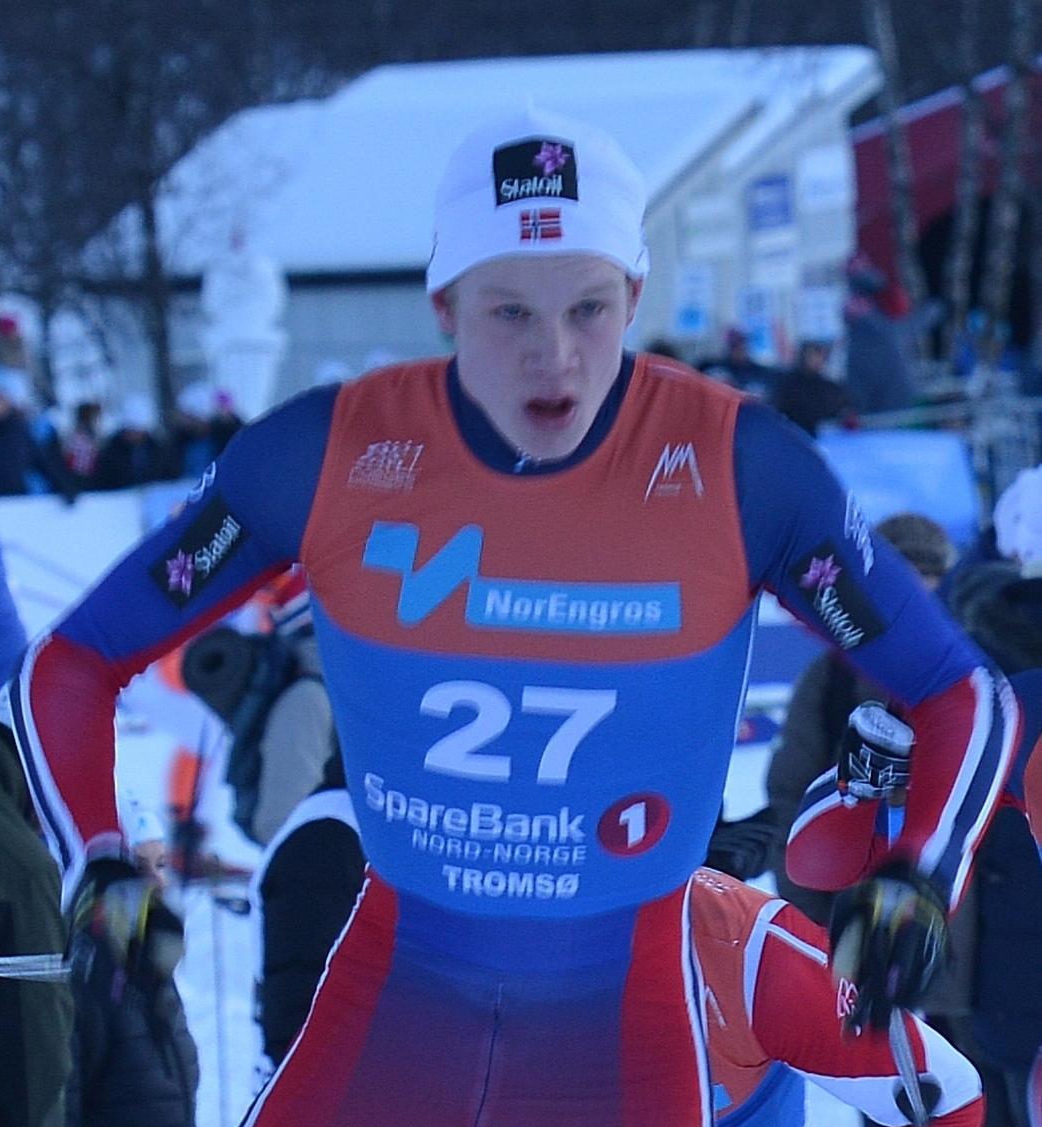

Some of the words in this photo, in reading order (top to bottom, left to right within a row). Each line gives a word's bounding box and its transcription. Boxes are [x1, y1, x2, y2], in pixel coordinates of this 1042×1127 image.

[500, 174, 563, 199] Statoil
[194, 515, 241, 579] Statoil
[484, 588, 663, 630] NorEngros
[814, 586, 865, 650] Statoil
[419, 679, 618, 786] 27
[364, 772, 586, 845] SpareBank
[619, 801, 647, 849] 1
[412, 829, 588, 866] NORD-NORGE
[441, 864, 581, 899] TROMSØ
